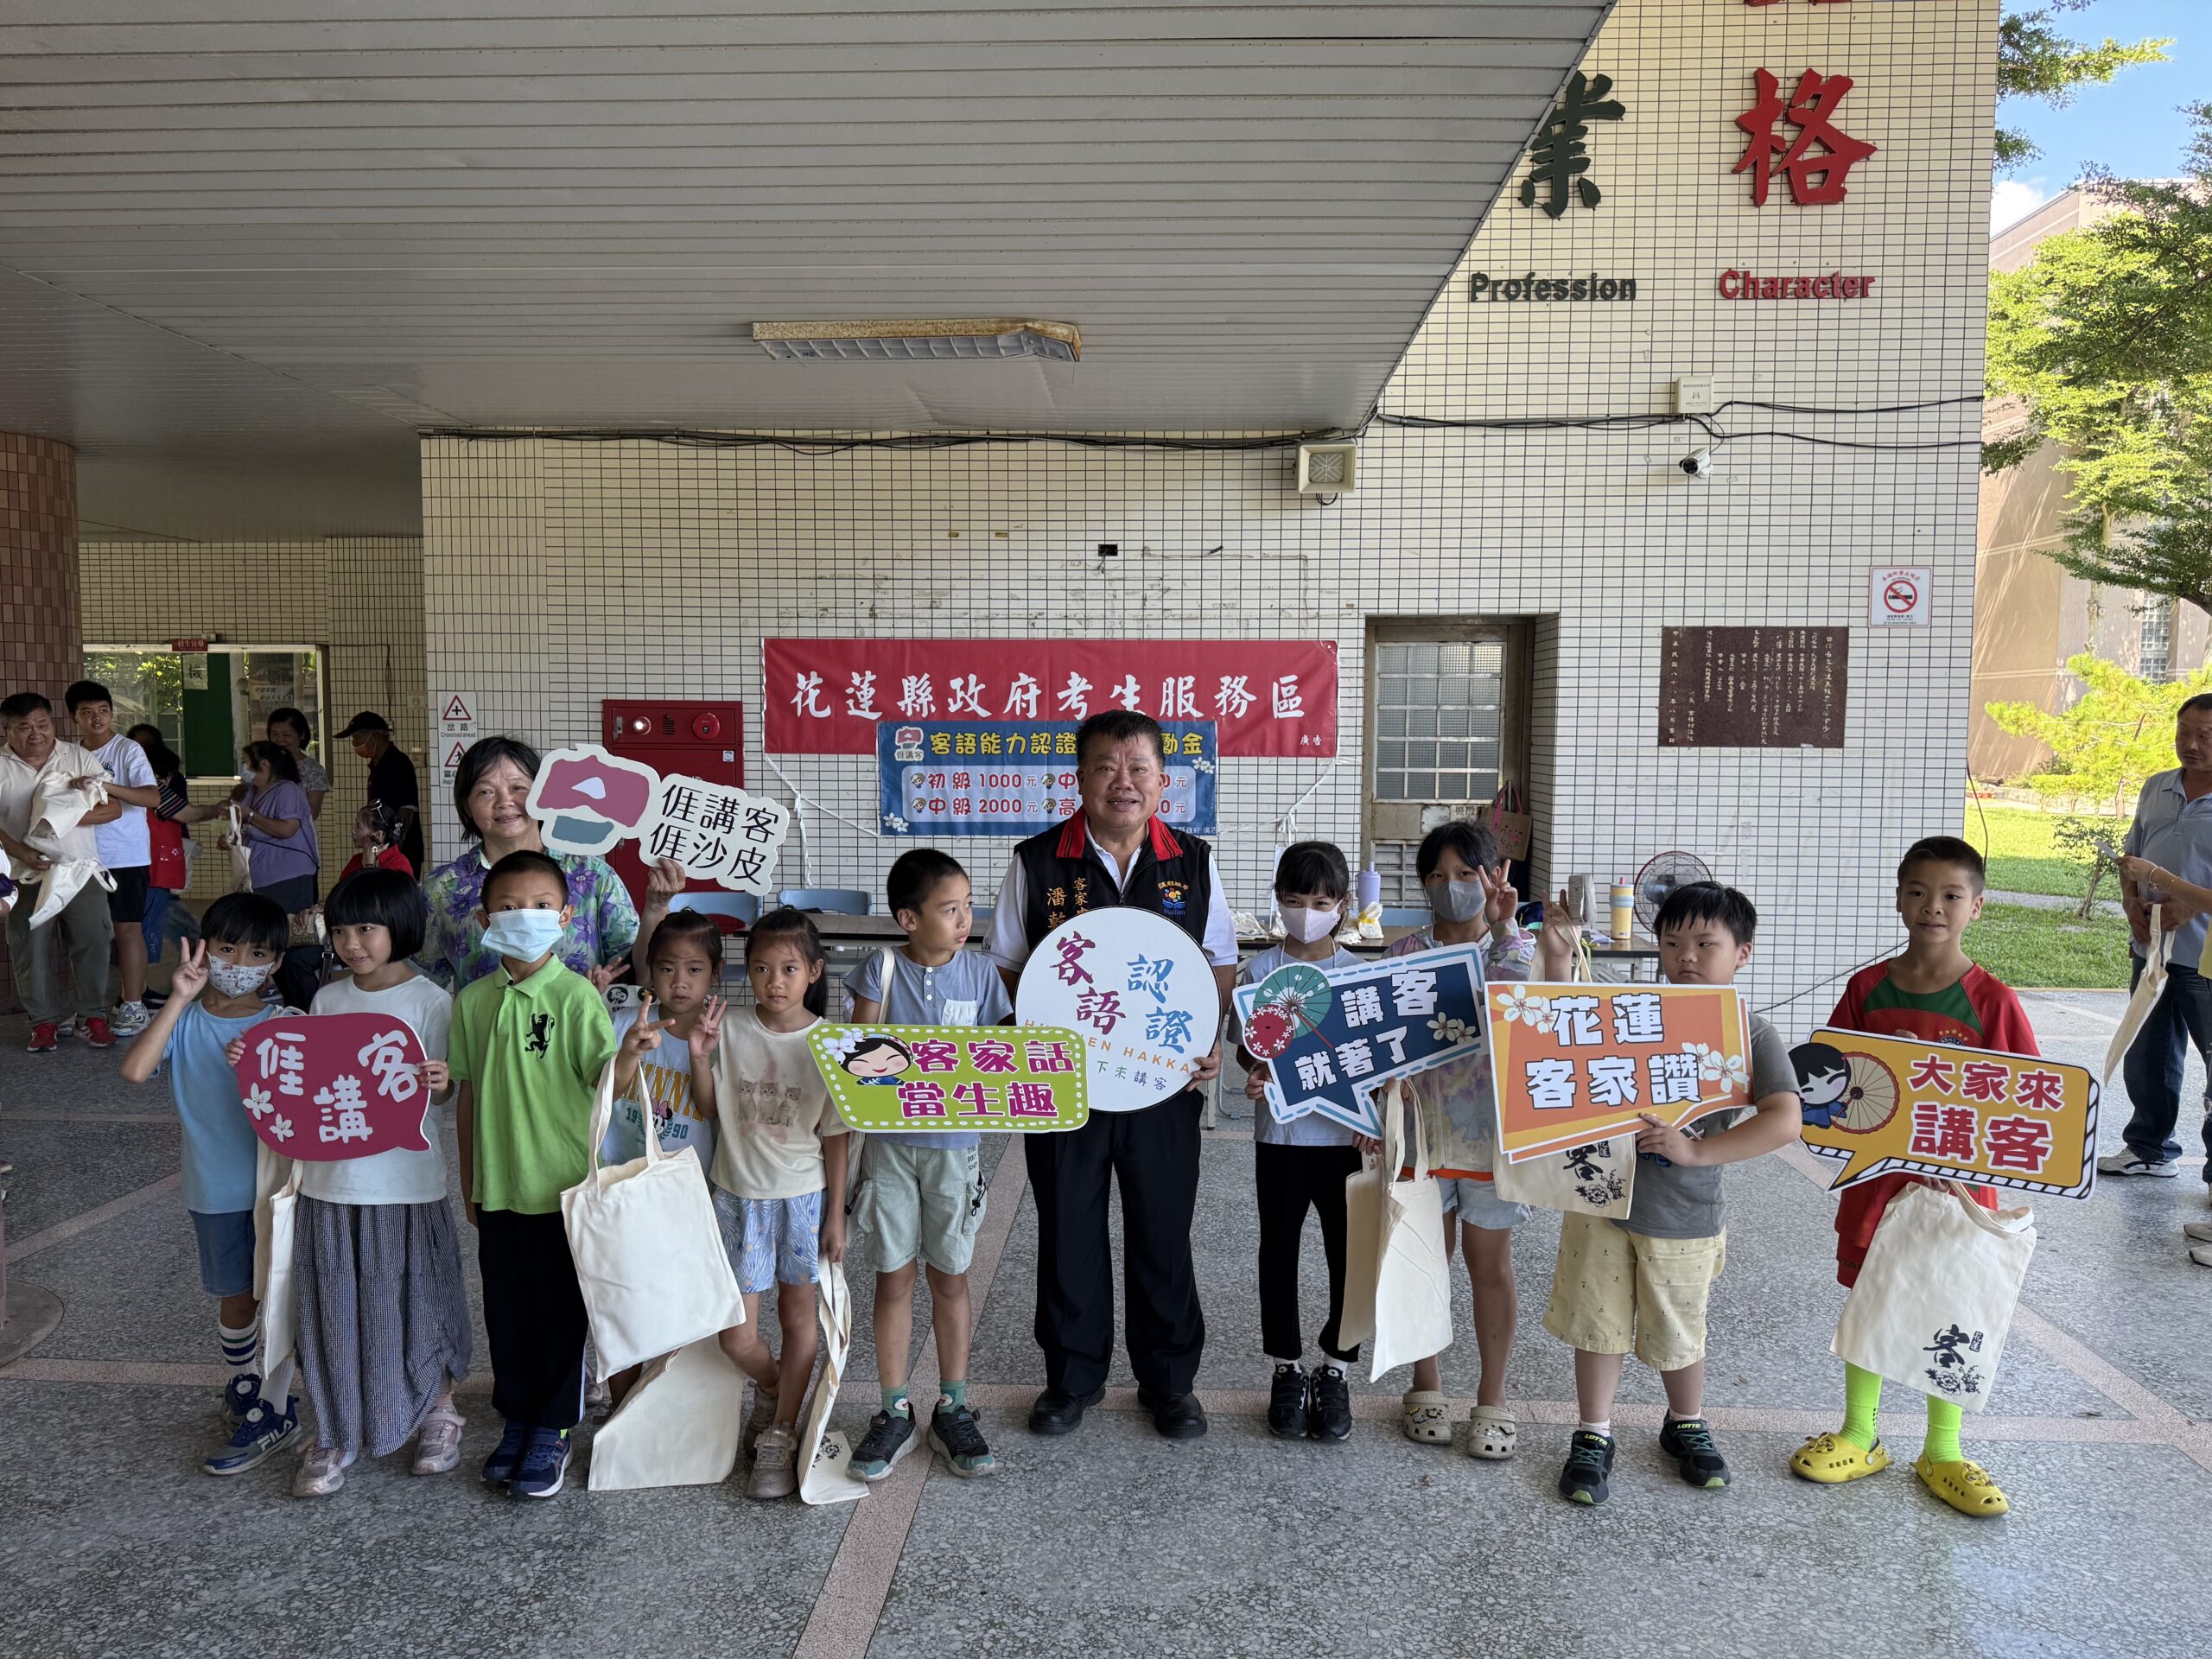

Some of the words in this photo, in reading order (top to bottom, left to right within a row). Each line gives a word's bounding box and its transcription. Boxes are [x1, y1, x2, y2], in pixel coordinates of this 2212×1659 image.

[1520, 70, 1626, 219] 業
[1733, 67, 1878, 207] 格
[1470, 271, 1636, 302] Profession
[1719, 270, 1875, 299] Character
[790, 671, 1305, 720] 花蓮縣政府考生服務區
[1300, 734, 1322, 746] 廣告
[1341, 969, 1439, 1029] 講客
[1550, 994, 1665, 1047] 花蓮
[911, 1039, 1075, 1076] 客家話
[1123, 1046, 1190, 1074] HAKKA
[1294, 1026, 1409, 1092] 就著了
[897, 1081, 1059, 1119] 當生趣
[1910, 1054, 2064, 1111] 大家來
[1910, 1104, 2053, 1173] 講客
[257, 1419, 293, 1452] FILA
[1585, 1433, 1608, 1446] LOTTO
